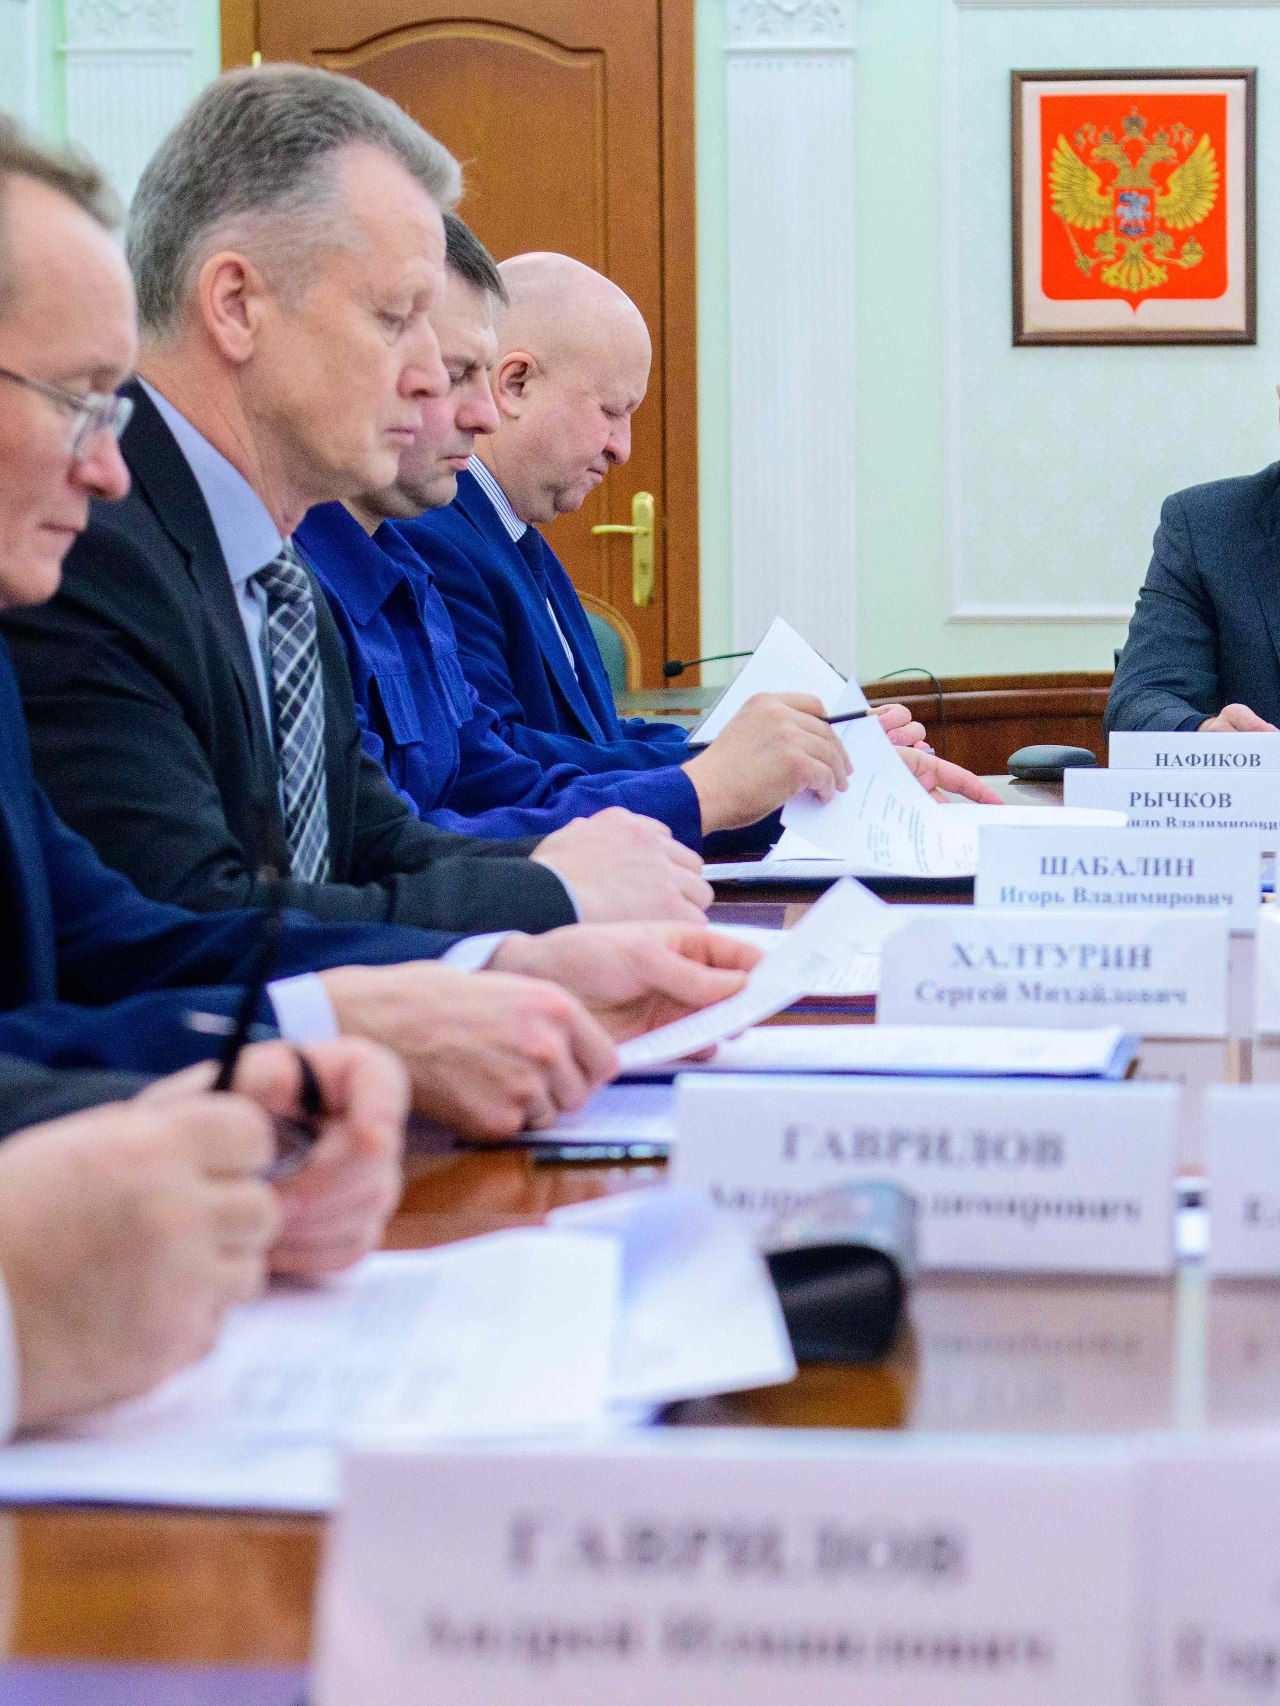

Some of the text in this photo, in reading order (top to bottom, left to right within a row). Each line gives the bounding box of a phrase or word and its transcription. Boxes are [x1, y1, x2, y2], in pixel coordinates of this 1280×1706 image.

[1155, 753, 1262, 767] НАФИКОВ
[1129, 792, 1232, 808] РЫЧКОВ
[1040, 856, 1194, 877] ШАБАЛИН
[1000, 886, 1233, 908] Игорь Владимирович
[952, 942, 1153, 969] ХАЛТУРИН
[915, 980, 1188, 1004] Сергей Михайлович
[781, 1124, 1066, 1168] ГАВРИЛОВ
